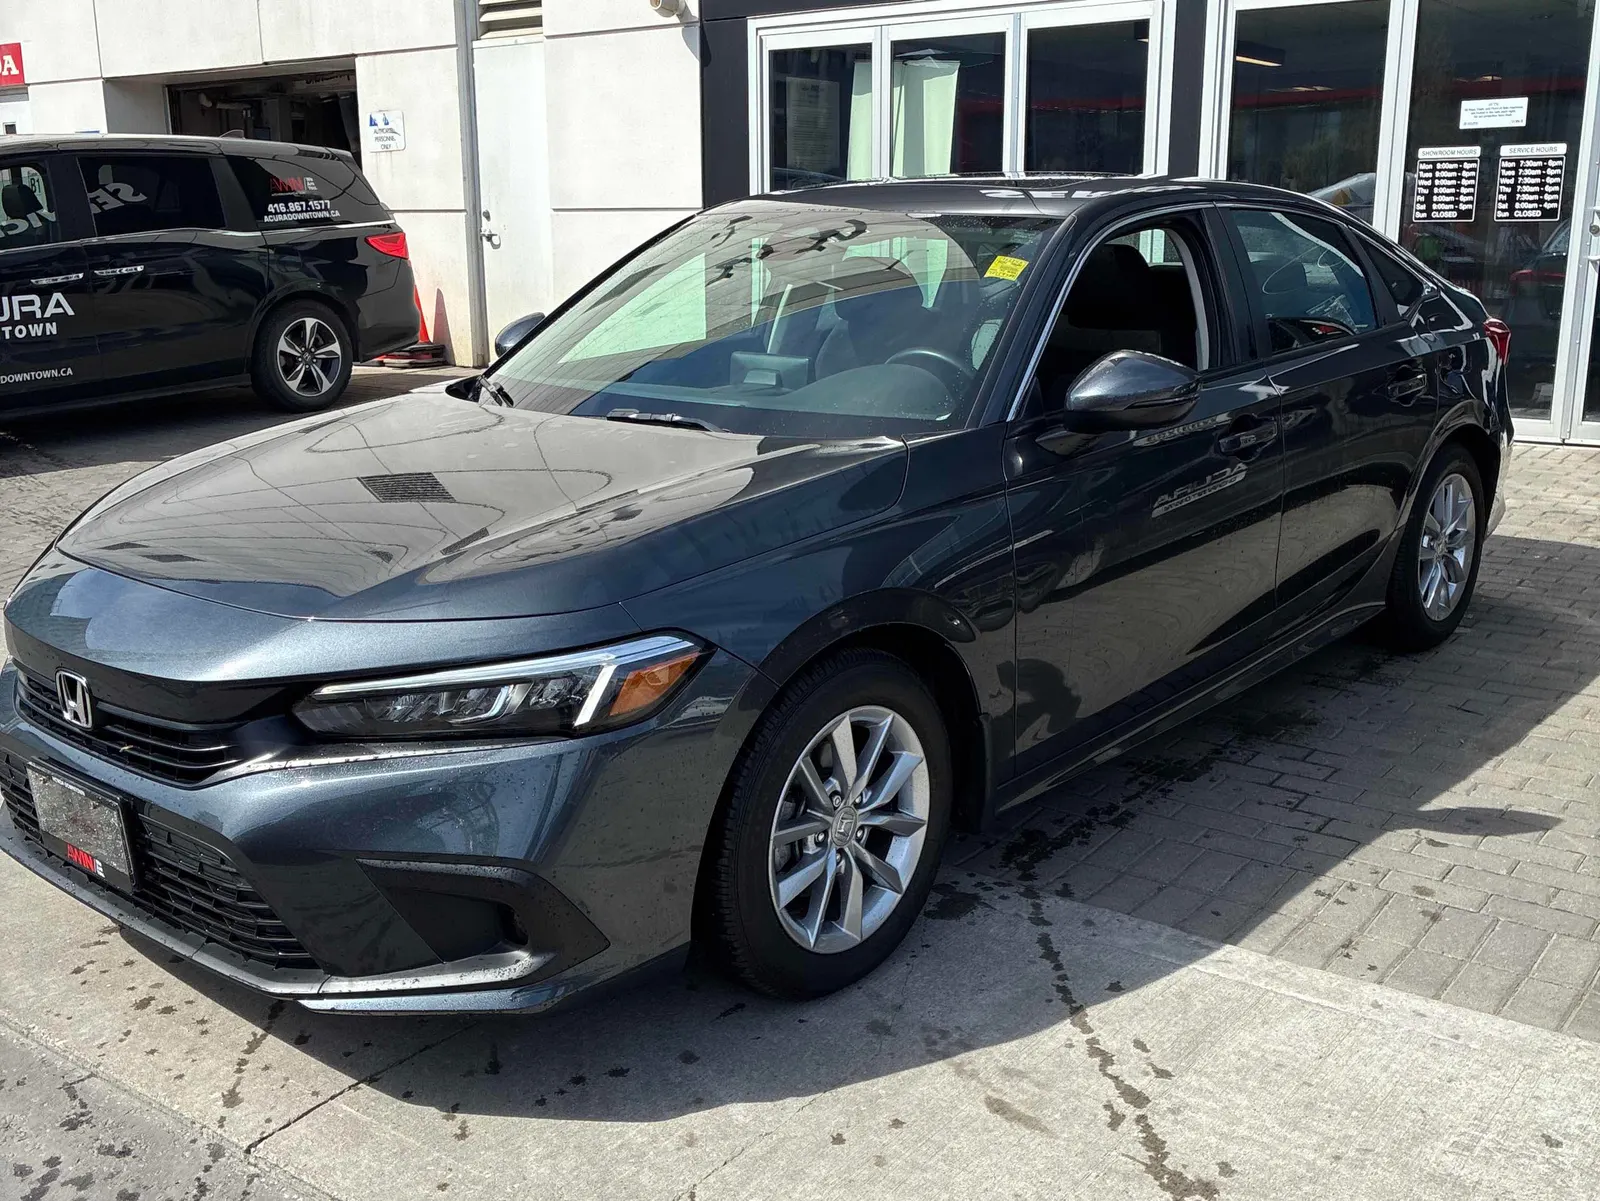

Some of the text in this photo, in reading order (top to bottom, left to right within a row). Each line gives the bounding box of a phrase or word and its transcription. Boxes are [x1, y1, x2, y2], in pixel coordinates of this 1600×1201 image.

[0, 55, 19, 75] A
[1548, 159, 1562, 167] 6pm
[1547, 168, 1561, 176] 6pm
[1546, 176, 1560, 184] 6pm
[1545, 185, 1559, 193] 6pm
[1544, 193, 1558, 201] 6pm
[268, 200, 331, 213] 416.867.1577
[264, 210, 341, 222] ACURADOWNTOWN.CA
[1, 322, 57, 340] TOWN
[0, 367, 73, 384] DOWNTOWN.CA
